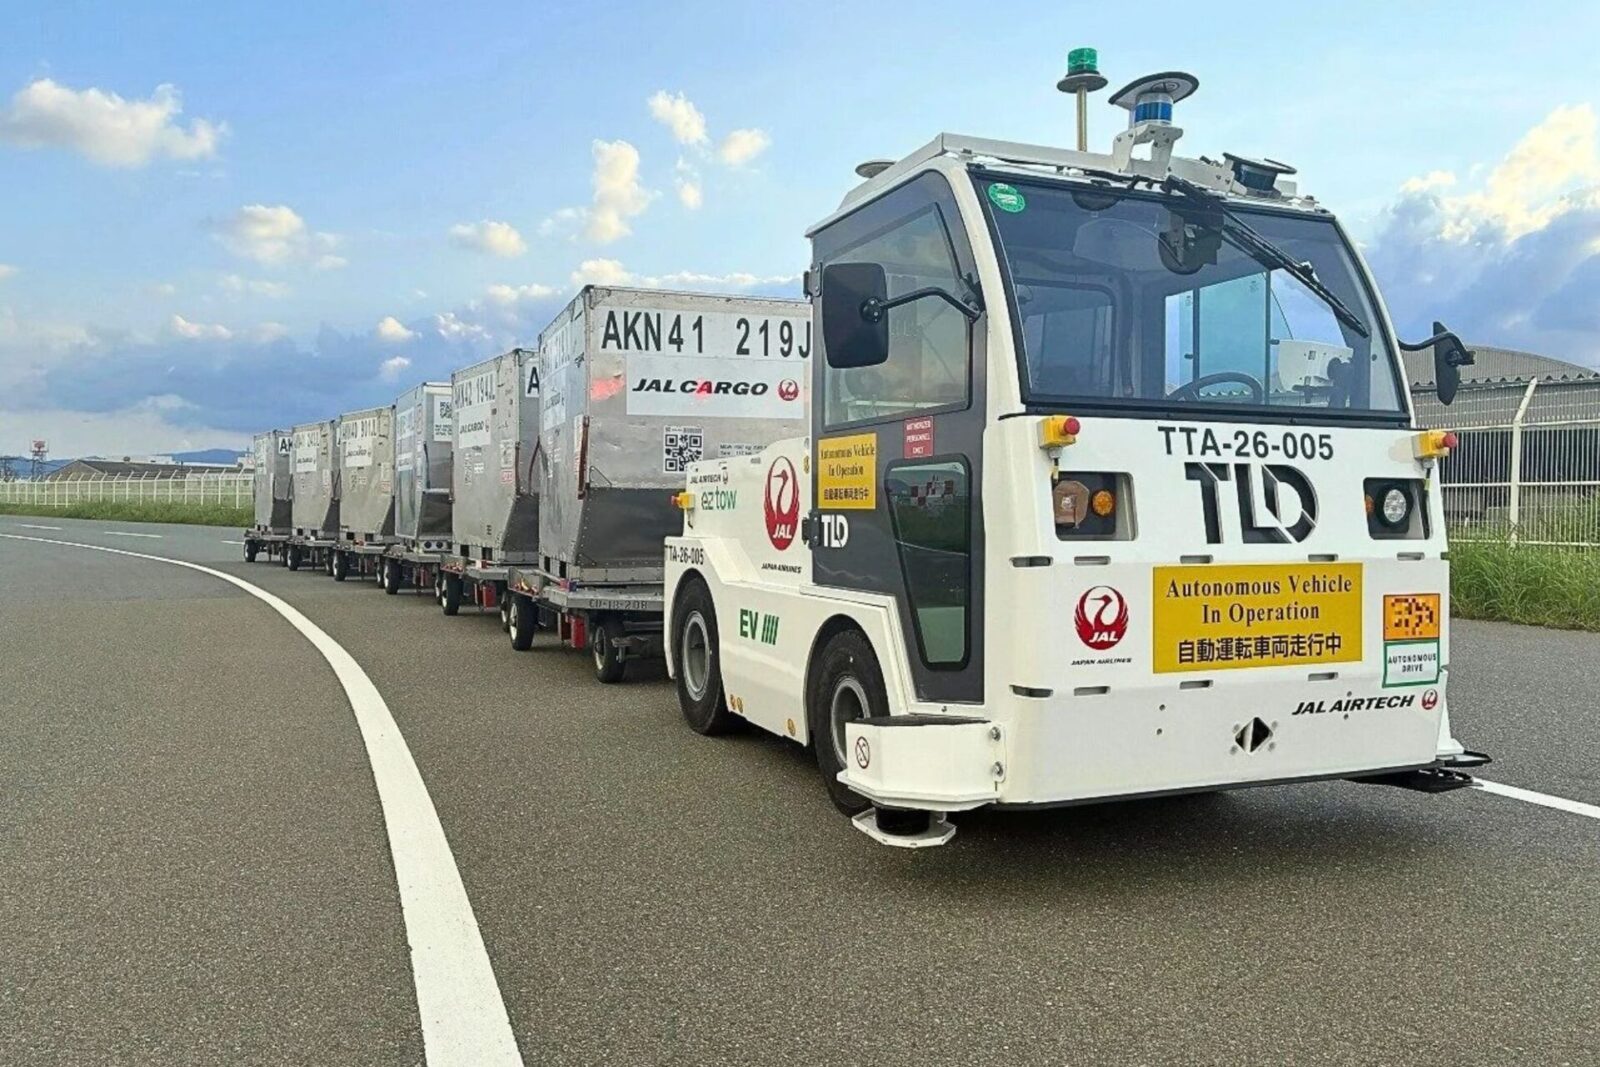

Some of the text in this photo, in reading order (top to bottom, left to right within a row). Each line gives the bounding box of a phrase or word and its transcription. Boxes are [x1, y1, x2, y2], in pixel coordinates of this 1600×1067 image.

[601, 310, 811, 358] AKN41 219J
[1157, 426, 1334, 461] TTA-26-005
[1184, 462, 1320, 544] TLD
[773, 524, 793, 539] JAL
[821, 514, 849, 548] TLD
[1166, 574, 1352, 598] Autonomous Vehicle
[740, 608, 758, 640] EV
[1202, 602, 1320, 627] In Operation
[1088, 630, 1119, 643] JAL
[1179, 632, 1342, 664] 自動運転車両走行中
[1096, 657, 1132, 665] AIRLINES
[1387, 653, 1437, 664] AUTONOMOUS
[1402, 664, 1423, 673] DRIVE
[1292, 695, 1416, 715] JAL AIRTECH
